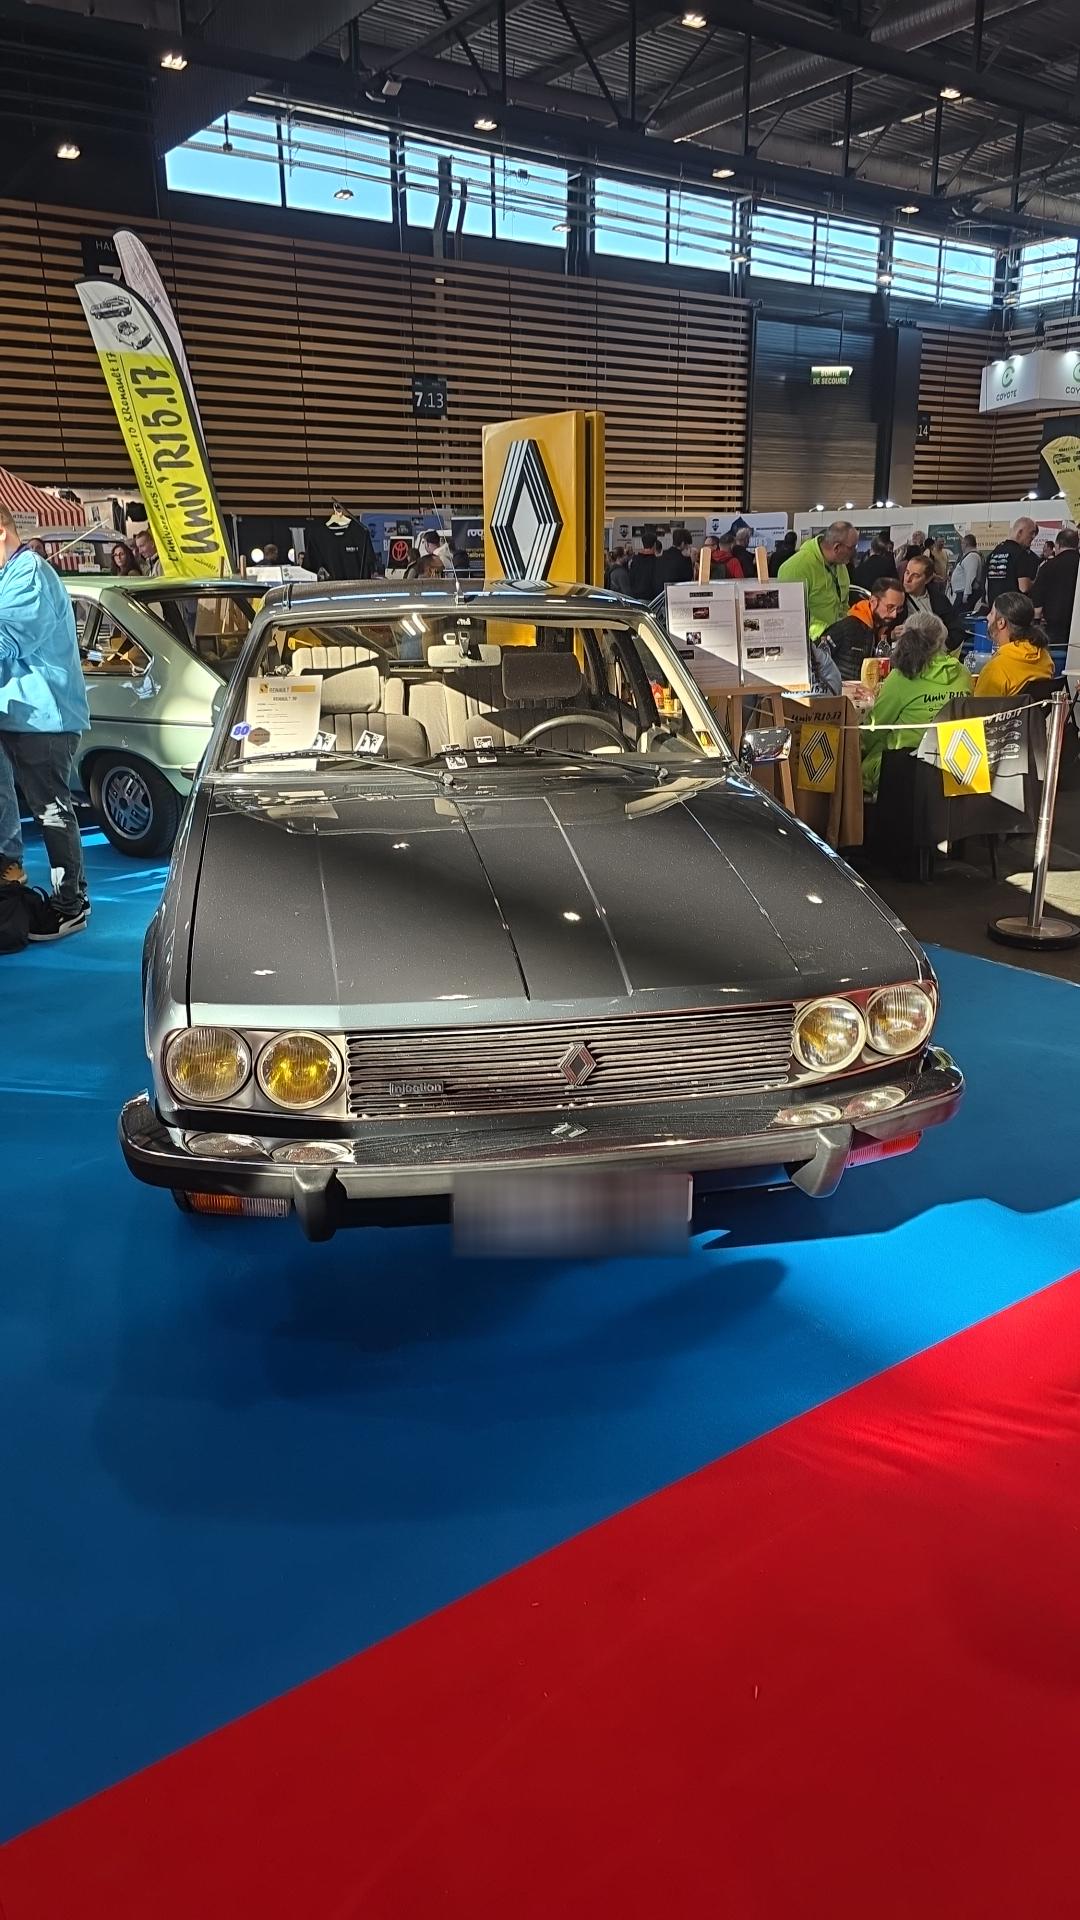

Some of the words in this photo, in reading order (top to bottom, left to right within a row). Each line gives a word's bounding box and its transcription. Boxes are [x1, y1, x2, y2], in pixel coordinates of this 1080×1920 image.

[95, 241, 115, 252] HAL
[821, 377, 847, 385] SECOURS
[414, 391, 444, 409] 7.13
[995, 388, 1018, 402] COYOTE
[129, 366, 220, 554] Univ'R15.17
[232, 725, 250, 736] 80
